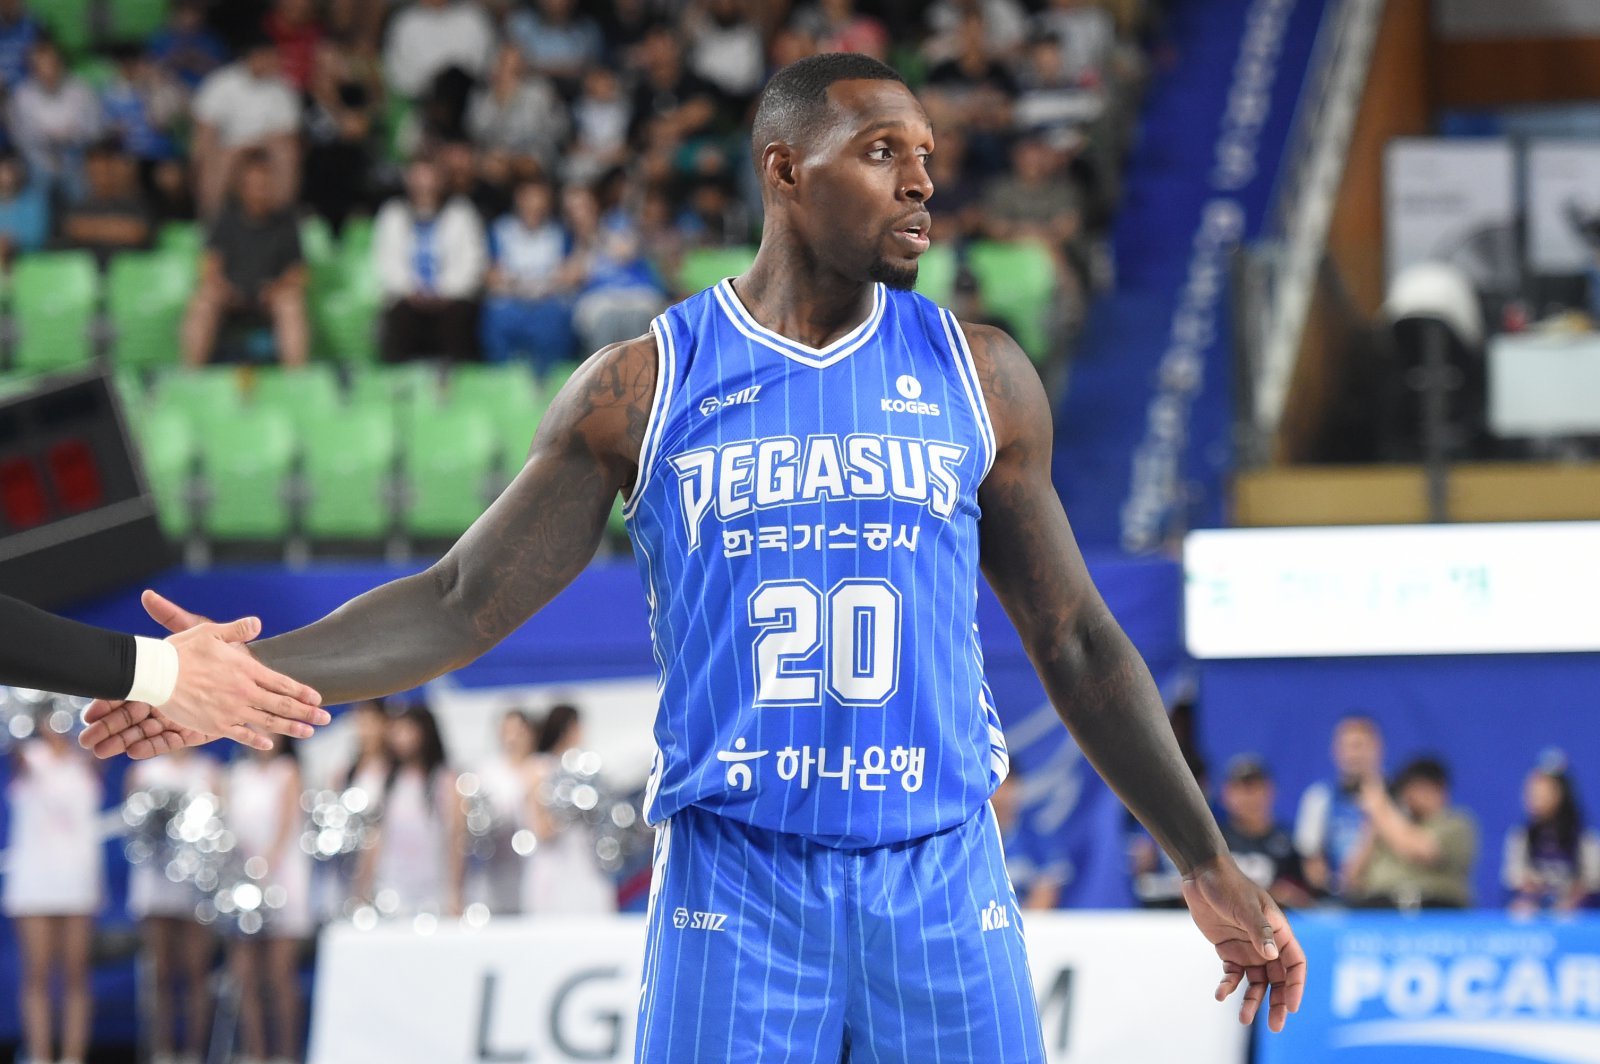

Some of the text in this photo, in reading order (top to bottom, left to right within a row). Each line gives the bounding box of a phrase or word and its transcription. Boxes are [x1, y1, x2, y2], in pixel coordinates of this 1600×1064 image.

[667, 433, 969, 556] PEGASUS
[722, 523, 921, 558] 한국가스공사
[748, 578, 902, 708] 20
[776, 745, 926, 792] 하나은행
[690, 911, 728, 932] STIZ
[474, 966, 628, 1064] LG
